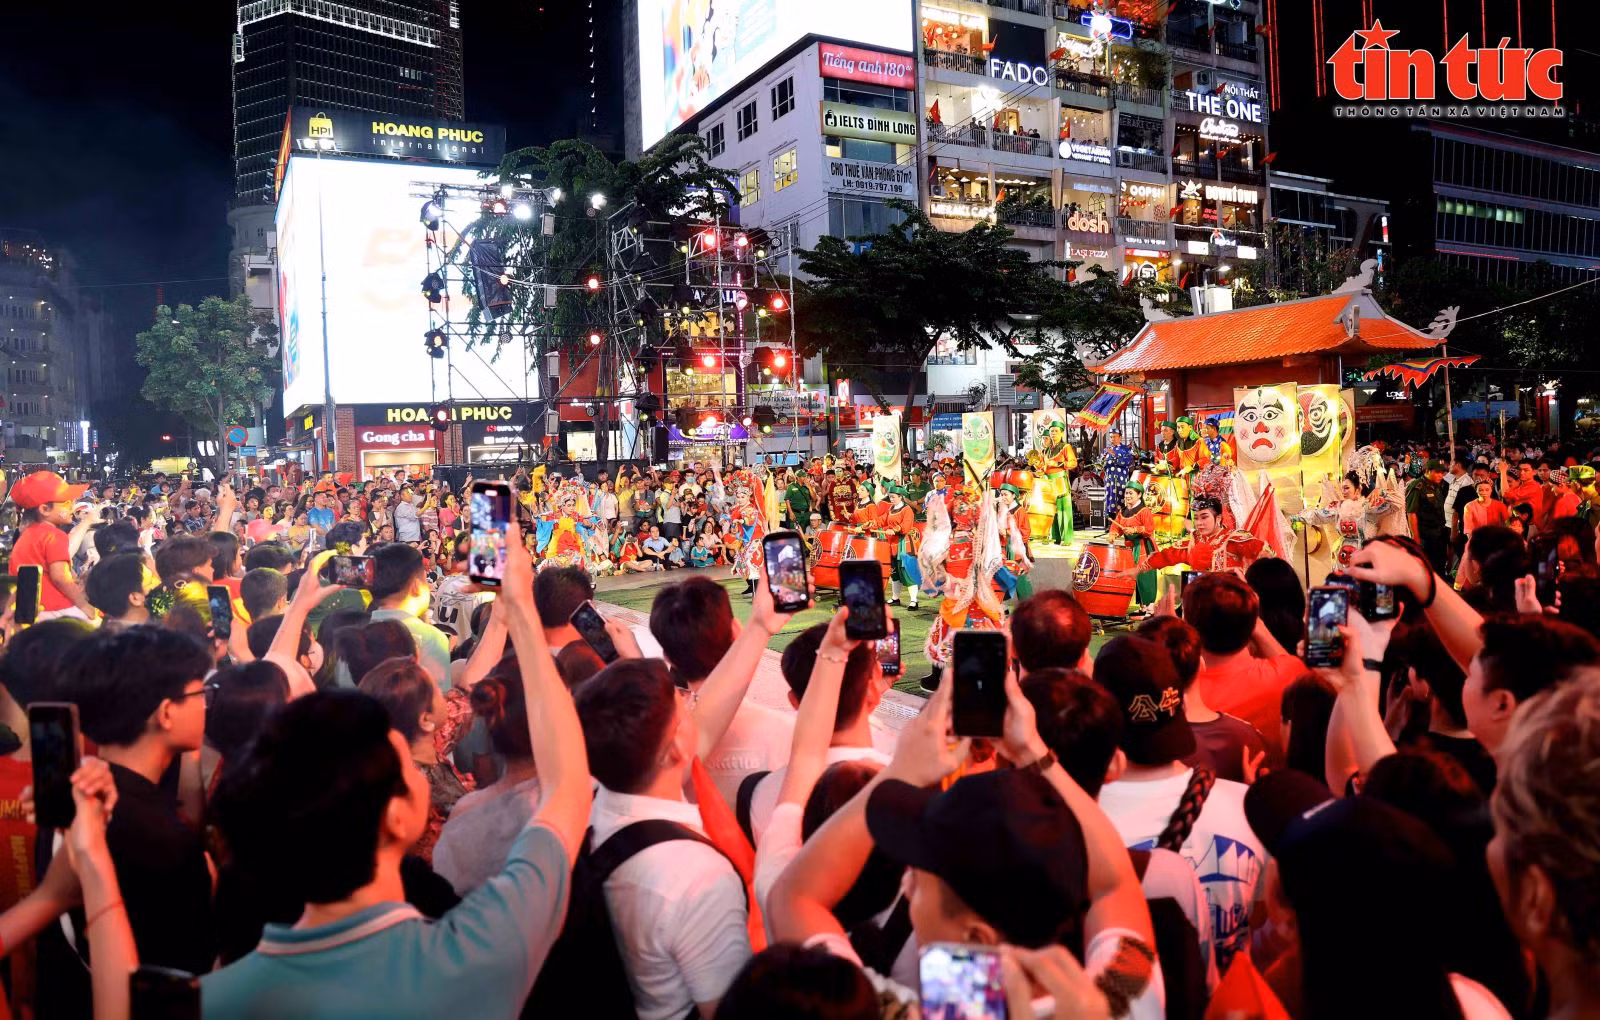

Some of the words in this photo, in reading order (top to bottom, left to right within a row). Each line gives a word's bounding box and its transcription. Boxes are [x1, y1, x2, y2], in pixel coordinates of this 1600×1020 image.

[822, 52, 855, 74] Tiếng
[991, 58, 1048, 86] FADO
[1225, 84, 1239, 96] NỘI
[1240, 86, 1260, 99] THẤT
[1185, 91, 1221, 116] THE
[1226, 99, 1262, 123] ONE
[311, 126, 331, 136] HPI
[372, 121, 434, 139] HOANG
[438, 127, 484, 143] PHUC
[839, 115, 865, 129] IELTS
[892, 122, 916, 135] LONG
[372, 137, 485, 155] international
[831, 162, 844, 176] CHO
[842, 179, 854, 188] LH:
[855, 180, 903, 193] 0919.797.199
[1205, 185, 1258, 205] DOWNTOWN
[1067, 210, 1109, 234] dosh
[1089, 250, 1109, 258] PIZZA
[387, 408, 457, 422] HOA
[461, 406, 512, 421] PHUC
[362, 431, 400, 445] Gong
[401, 430, 425, 442] cha
